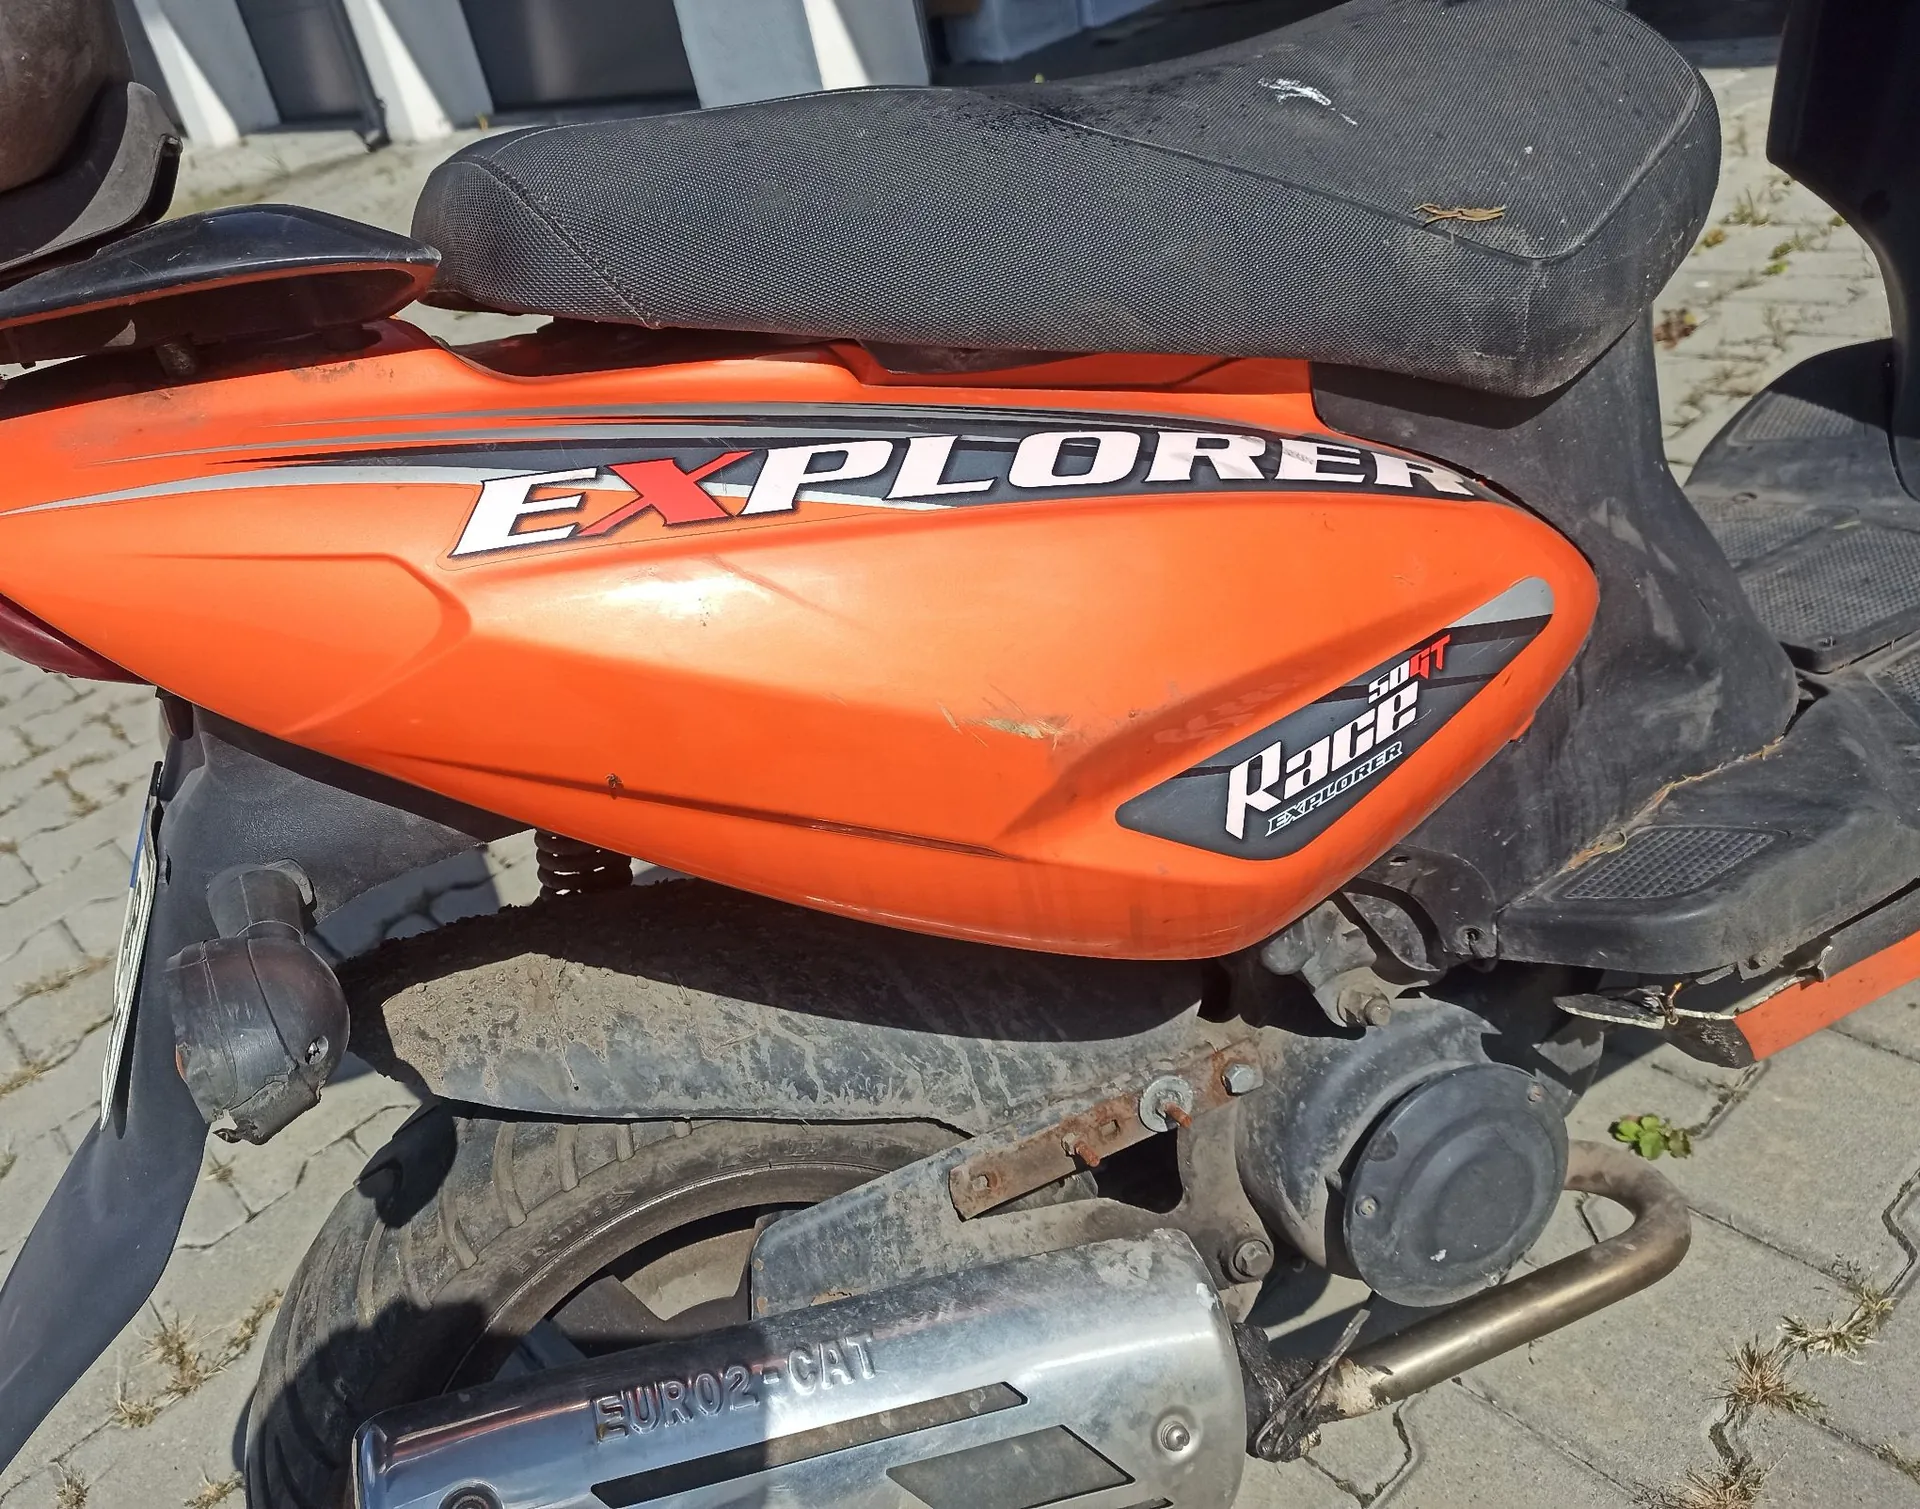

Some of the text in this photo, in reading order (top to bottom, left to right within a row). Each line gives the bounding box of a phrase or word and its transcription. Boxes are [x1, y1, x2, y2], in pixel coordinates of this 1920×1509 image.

[447, 430, 1475, 557] EXPLORER
[1225, 681, 1419, 840] Race
[1265, 741, 1403, 837] EXPLORER
[592, 1330, 879, 1446] EURO2-CAT
